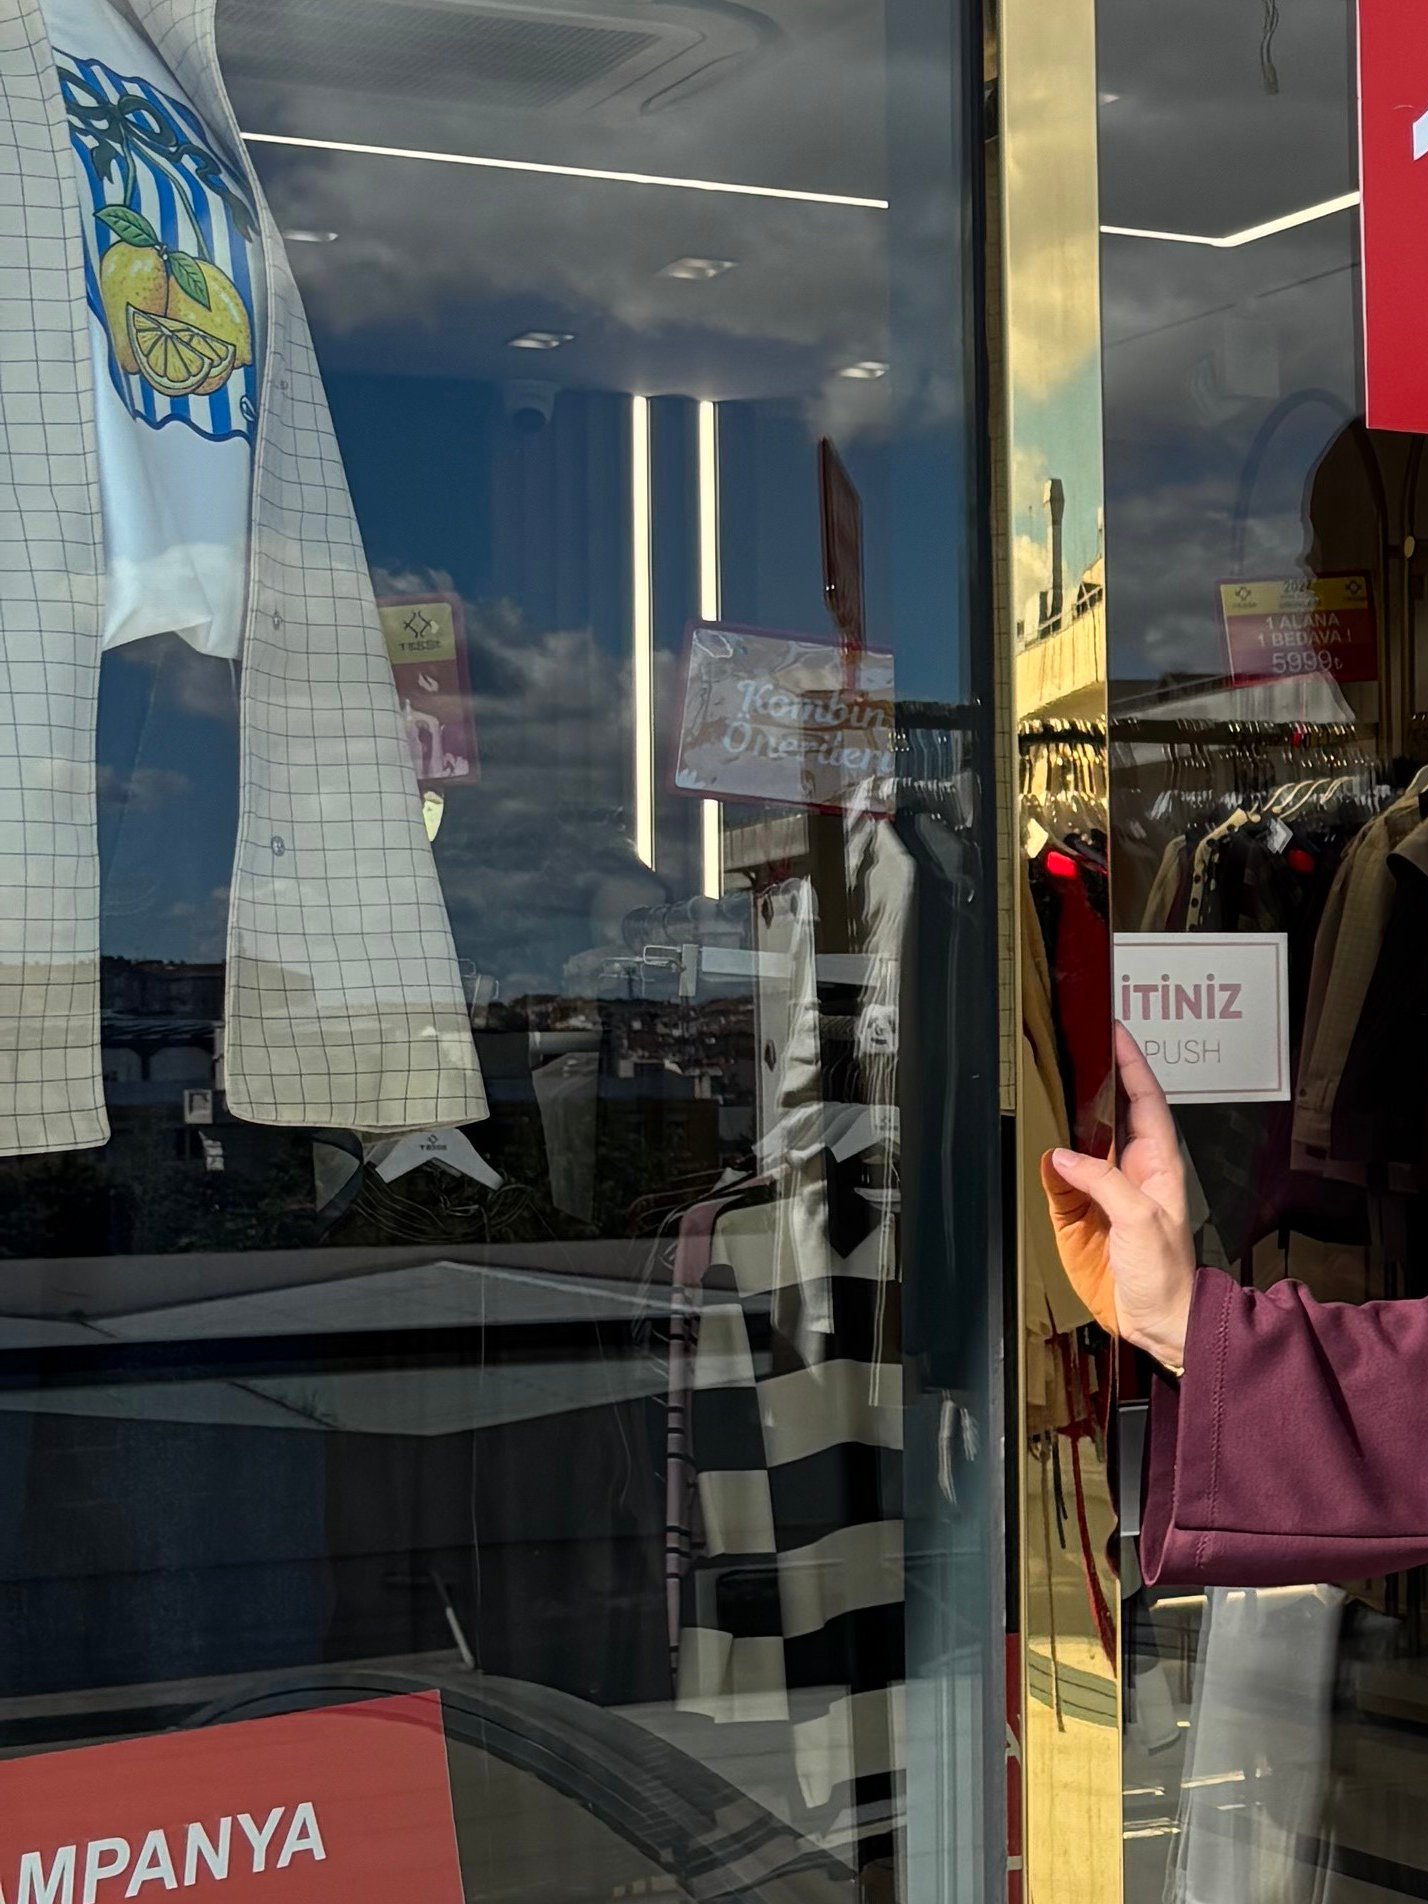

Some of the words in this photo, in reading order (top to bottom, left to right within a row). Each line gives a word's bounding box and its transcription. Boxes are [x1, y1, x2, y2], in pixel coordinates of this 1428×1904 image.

[1280, 612, 1340, 630] ALANA
[1272, 630, 1342, 647] BEDAVA
[1121, 973, 1243, 1021] İTİNİZ
[1144, 1039, 1221, 1065] PUSH
